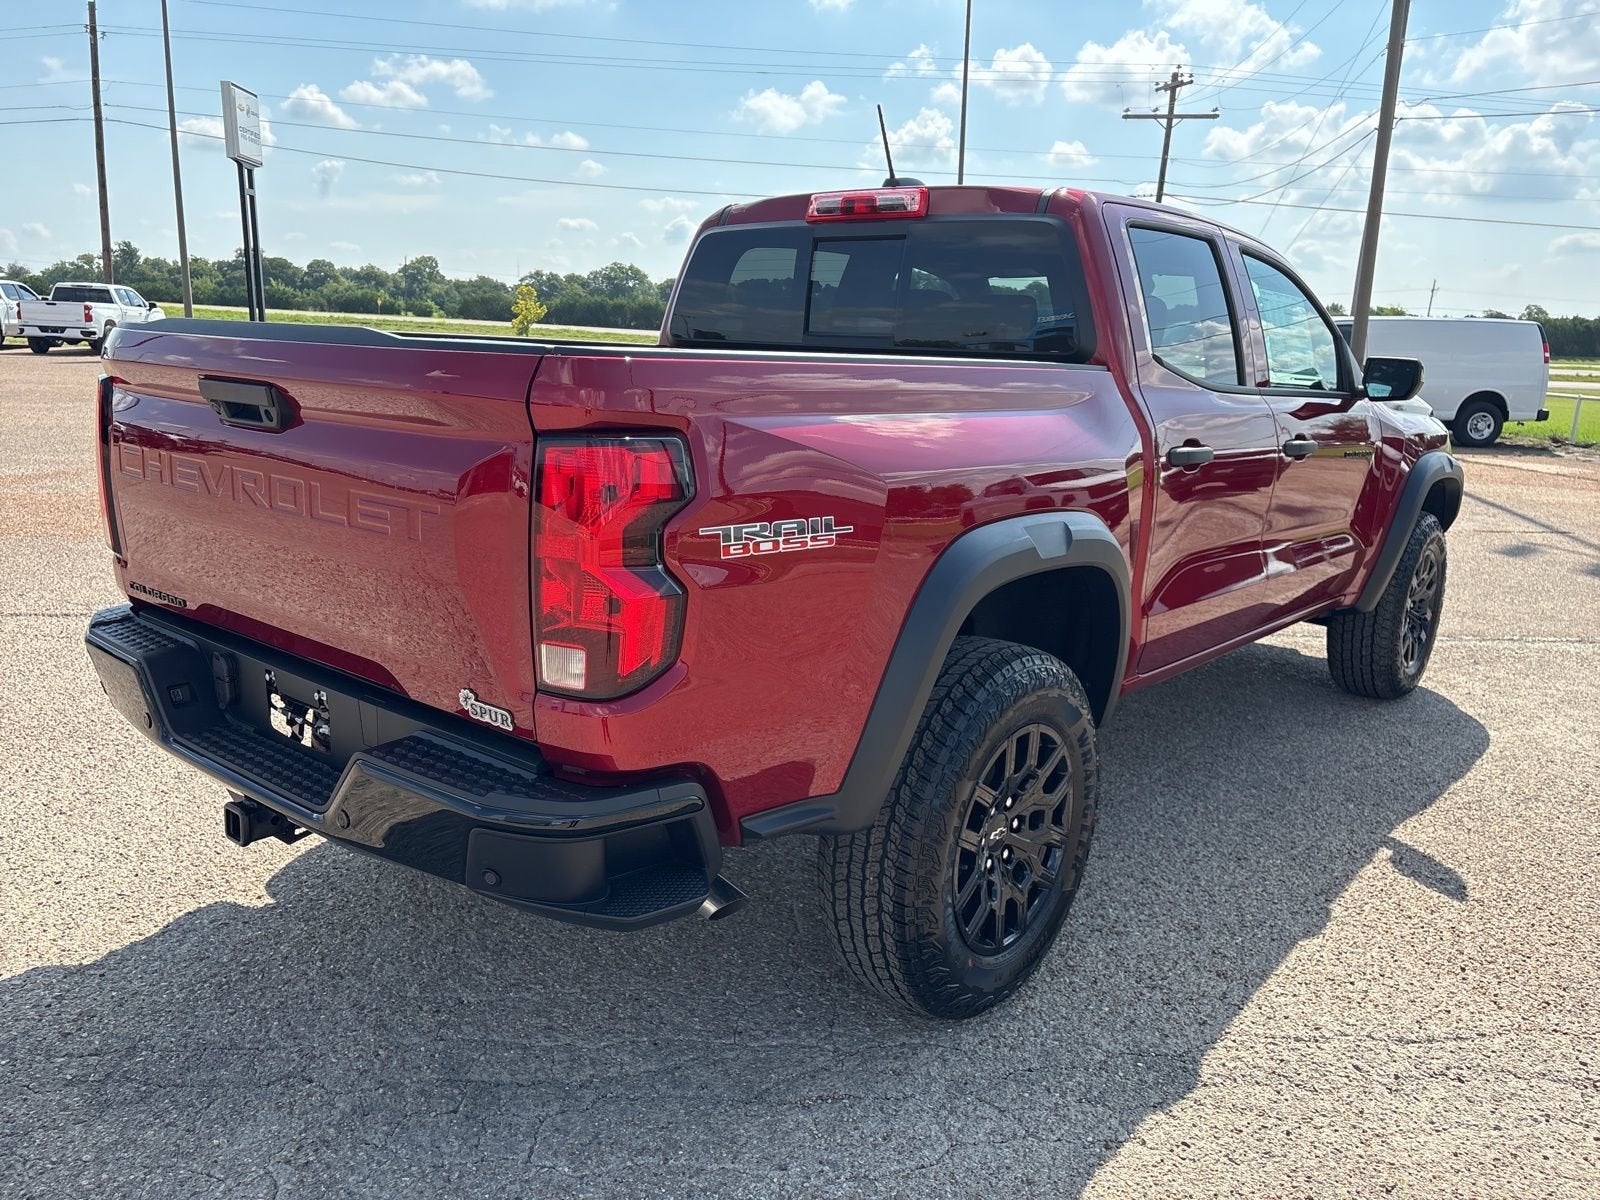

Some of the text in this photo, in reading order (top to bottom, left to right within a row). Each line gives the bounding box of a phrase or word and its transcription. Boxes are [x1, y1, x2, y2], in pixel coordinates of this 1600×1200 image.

[118, 440, 441, 542] CHEVROLET
[699, 516, 854, 545] TRAIL
[721, 533, 836, 559] BOSS
[129, 580, 188, 608] COLORADO
[470, 703, 512, 728] SPUR
